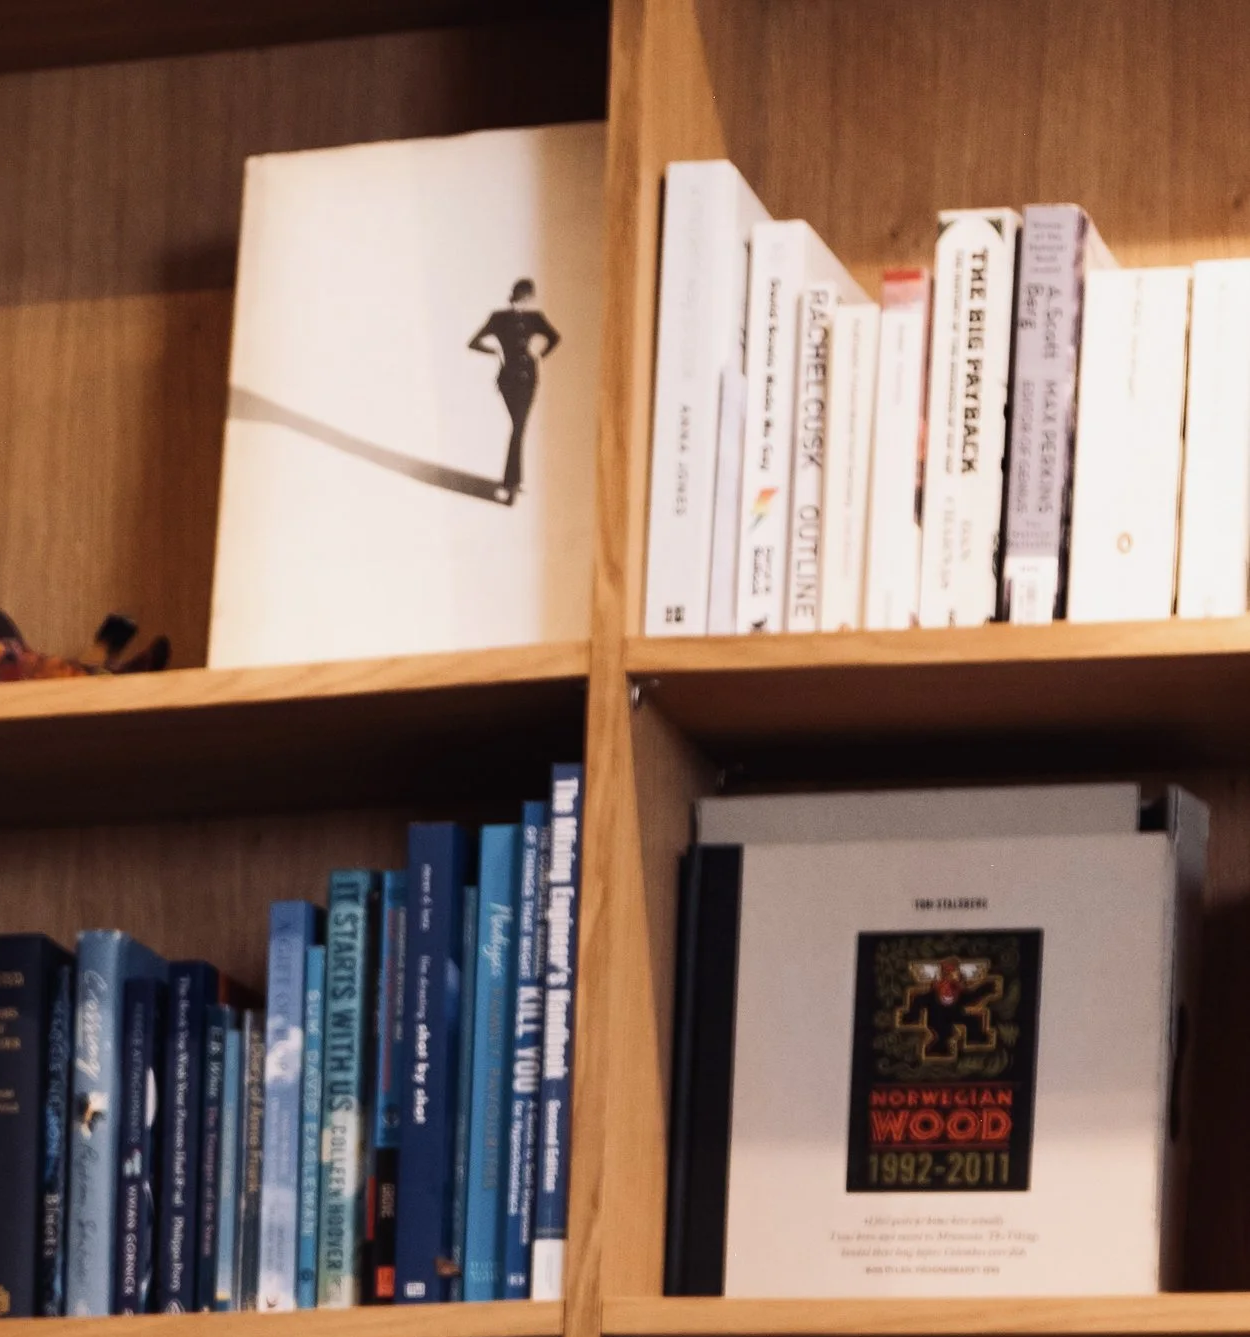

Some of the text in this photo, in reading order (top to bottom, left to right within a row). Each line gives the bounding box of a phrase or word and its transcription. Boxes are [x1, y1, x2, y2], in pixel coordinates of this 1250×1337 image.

[1018, 284, 1041, 329] Berg
[1043, 309, 1060, 360] Scott
[961, 248, 990, 474] THE BIG PAYBACK
[678, 405, 693, 454] ANNA
[1038, 380, 1058, 513] MAX PERKINS
[795, 290, 830, 617] RACHEL CUSK OUTLINE
[519, 825, 537, 980] OF THINGS THAT MIGHT
[416, 977, 429, 1019] directing
[544, 778, 579, 1193] The Mixing Engineer's Handbook Second Edition
[76, 970, 109, 1081] Crossing
[414, 1024, 431, 1058] shot
[513, 984, 544, 1093] KILL YOU
[176, 1052, 189, 1080] Wish
[208, 1061, 222, 1098] White
[327, 883, 359, 1270] IT STARTS WITH US COLLEEN HOOVER
[411, 1062, 430, 1083] by
[175, 1083, 188, 1105] Your
[301, 990, 321, 1236] SUM DAVID EAGLEMAN
[412, 1089, 428, 1124] shot
[870, 1087, 1013, 1106] NORWEGIAN
[174, 1109, 188, 1148] Parents
[248, 1106, 263, 1145] Anne
[527, 1112, 537, 1144] Guide
[869, 1106, 1012, 1142] WOOD
[125, 1049, 143, 1295] ATTACHMENTS VIVIAN GORNICK
[204, 1132, 217, 1182] Trumpet
[247, 1148, 263, 1192] Frank
[508, 1100, 526, 1216] for Hypochondriacs
[868, 1151, 1011, 1185] 1992-2011
[380, 1184, 394, 1218] GROVE
[44, 1192, 60, 1257] Bluets
[169, 1215, 184, 1260] Philippa
[203, 1225, 215, 1257] Swan
[169, 1262, 183, 1289] Perry
